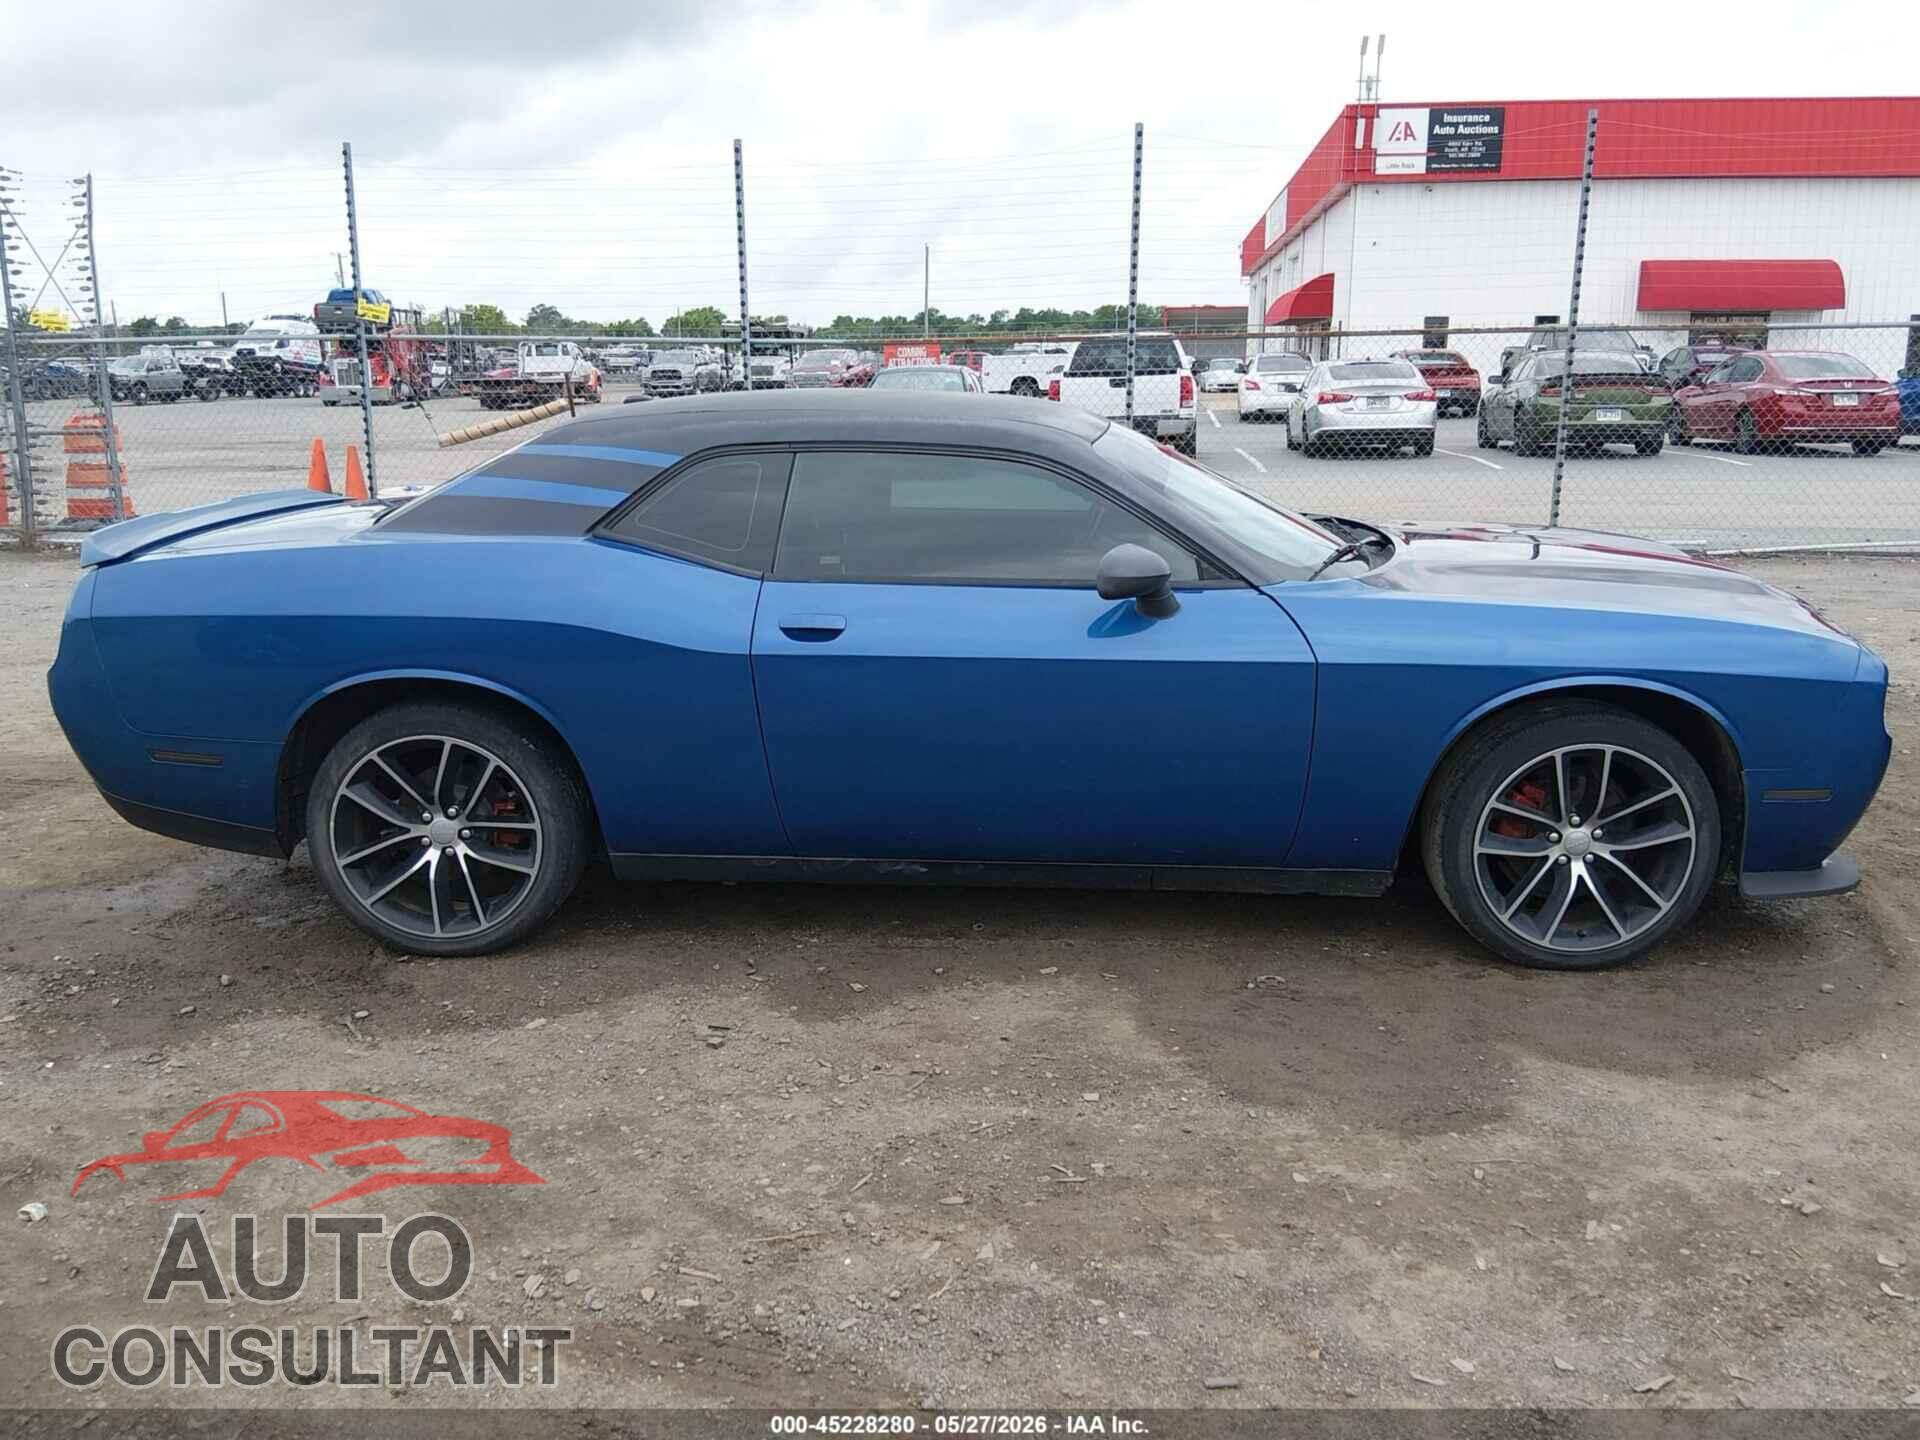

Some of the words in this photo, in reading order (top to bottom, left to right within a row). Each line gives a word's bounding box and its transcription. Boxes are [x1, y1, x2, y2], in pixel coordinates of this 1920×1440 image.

[1443, 113, 1490, 123] Insurance
[1433, 126, 1455, 136] Auto
[1457, 124, 1500, 135] Auctions
[896, 346, 927, 357] COMING
